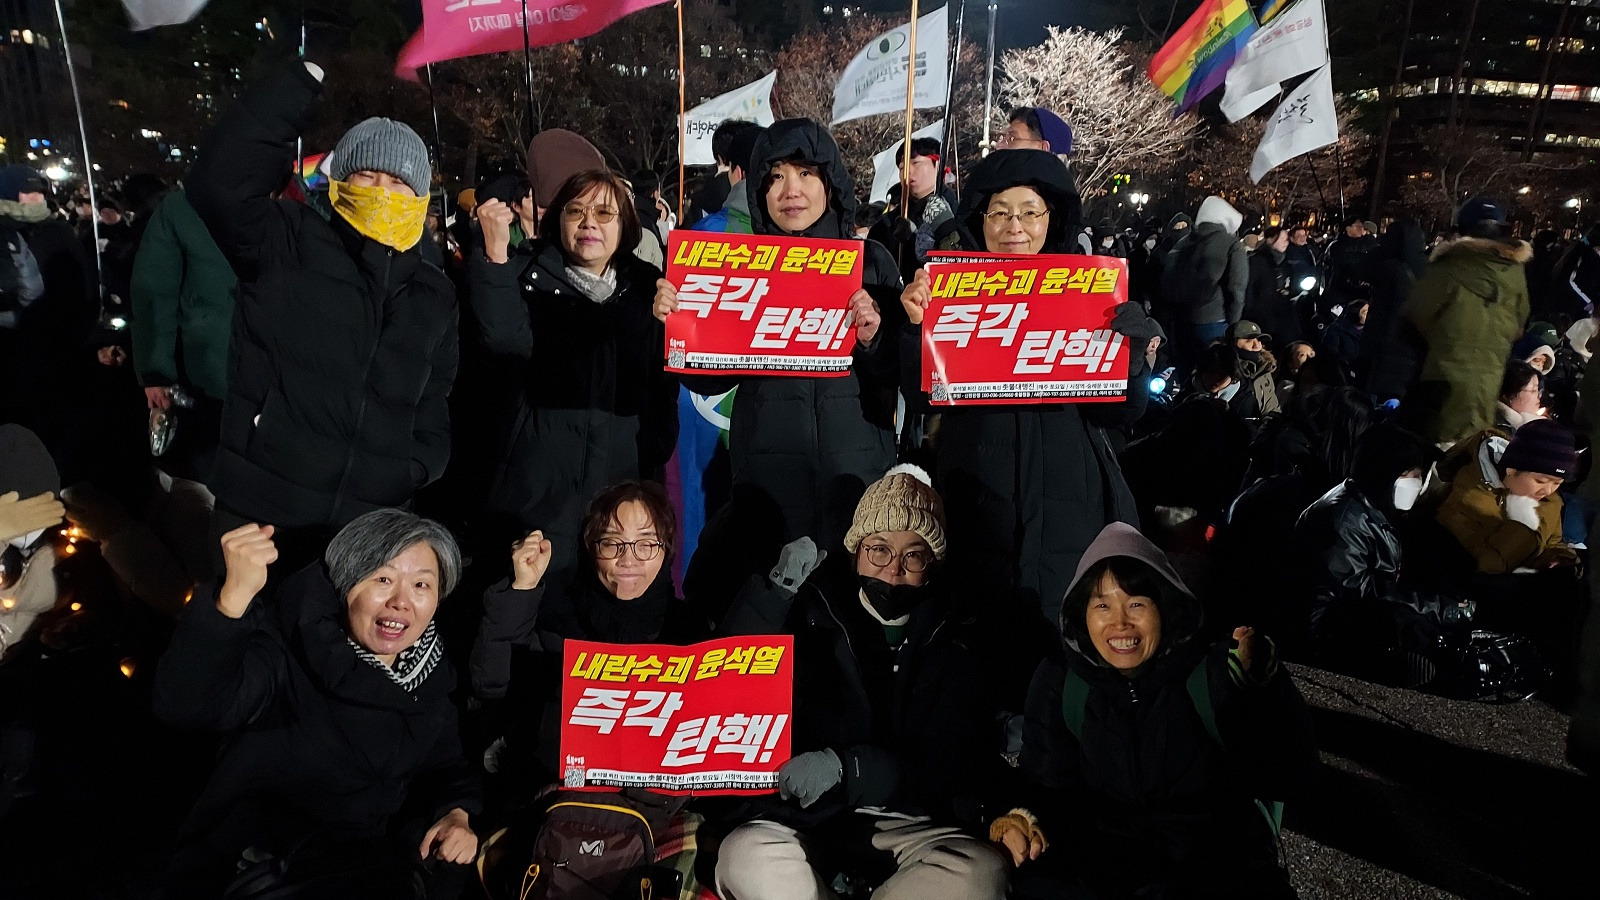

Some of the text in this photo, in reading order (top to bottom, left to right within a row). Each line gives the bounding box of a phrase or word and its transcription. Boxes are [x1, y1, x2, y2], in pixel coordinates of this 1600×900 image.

[673, 241, 859, 275] 내란수괴 윤석열
[677, 273, 769, 321] 즉각
[931, 267, 1120, 298] 내란수괴 윤석열
[750, 307, 852, 350] 탄핵!
[931, 302, 1030, 348] 즉각
[1013, 329, 1124, 374] 탄핵!
[570, 646, 785, 684] 내란수괴 윤석열
[569, 687, 684, 737] 즉각
[661, 713, 789, 767] 탄핵!
